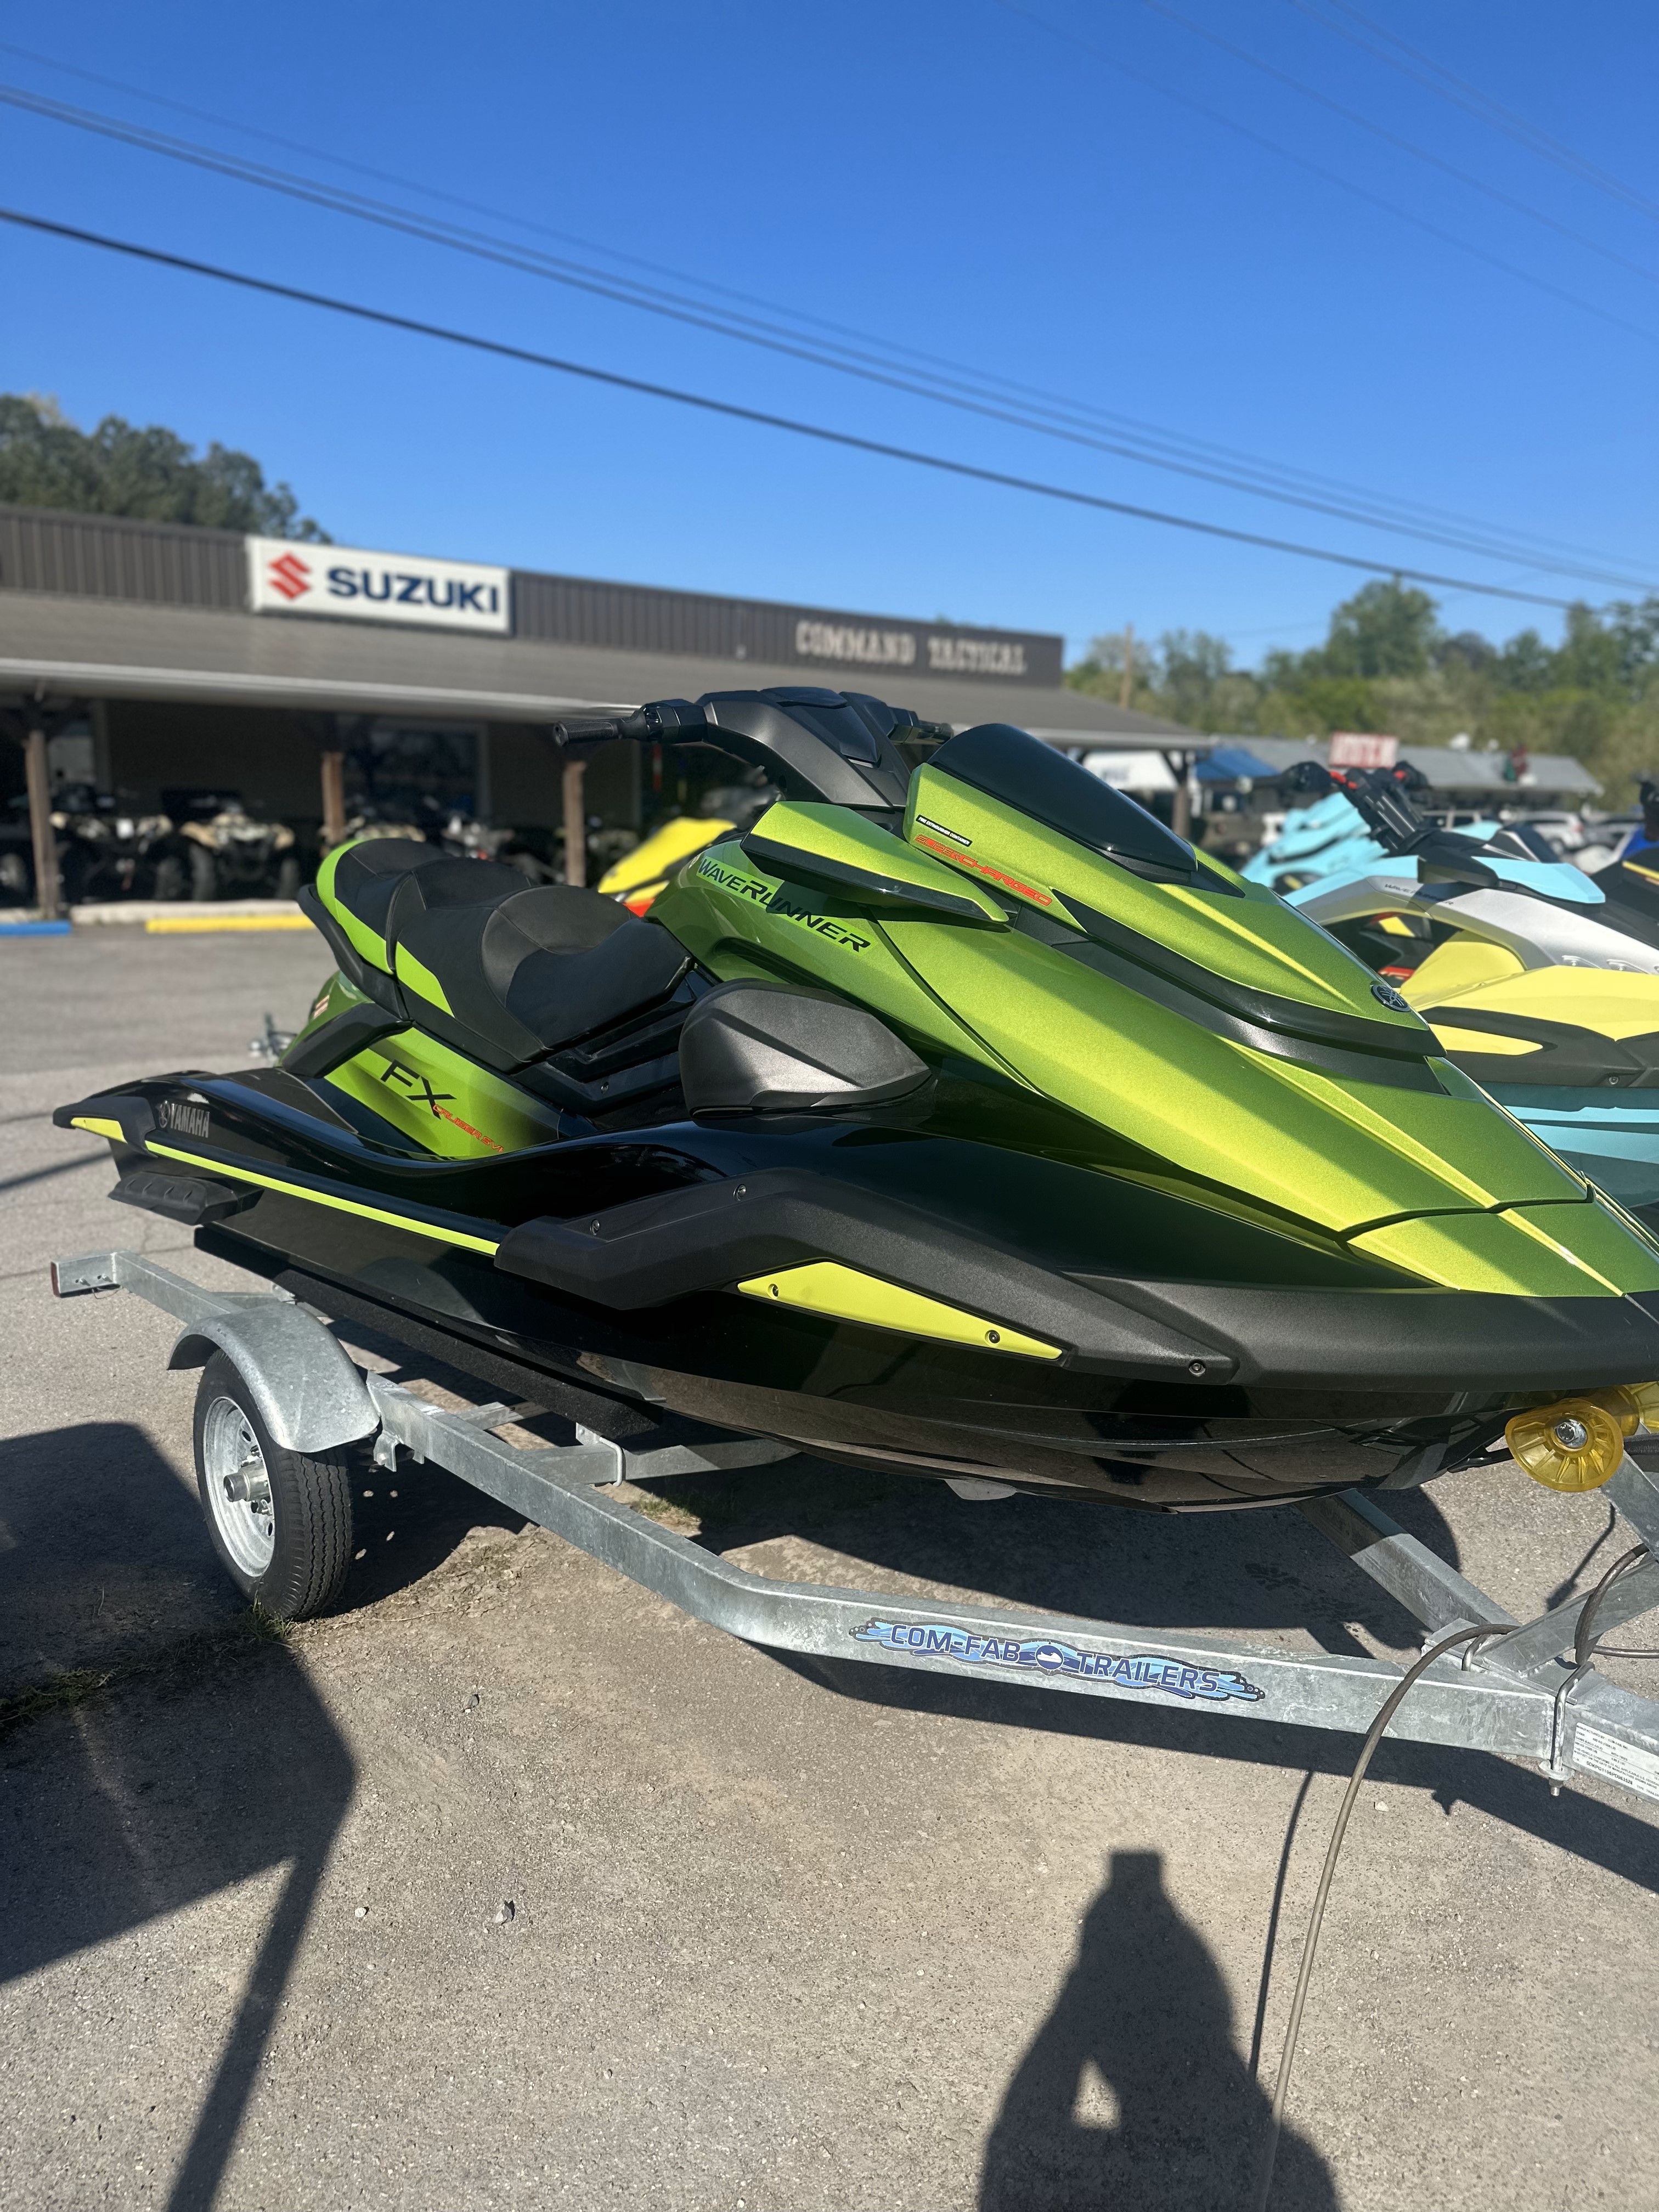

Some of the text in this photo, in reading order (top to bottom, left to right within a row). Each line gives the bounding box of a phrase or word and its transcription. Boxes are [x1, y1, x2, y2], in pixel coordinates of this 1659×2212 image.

[326, 566, 499, 613] SUZUKI
[795, 620, 1026, 675] COMMAND TACTICAL
[915, 834, 1052, 906] SUPERCHARGED
[698, 859, 871, 953] WAVERUNNER
[380, 1059, 457, 1120] FX
[171, 1103, 210, 1138] YAMAHA
[891, 1624, 1221, 1692] COM-FAB TRAILERS
